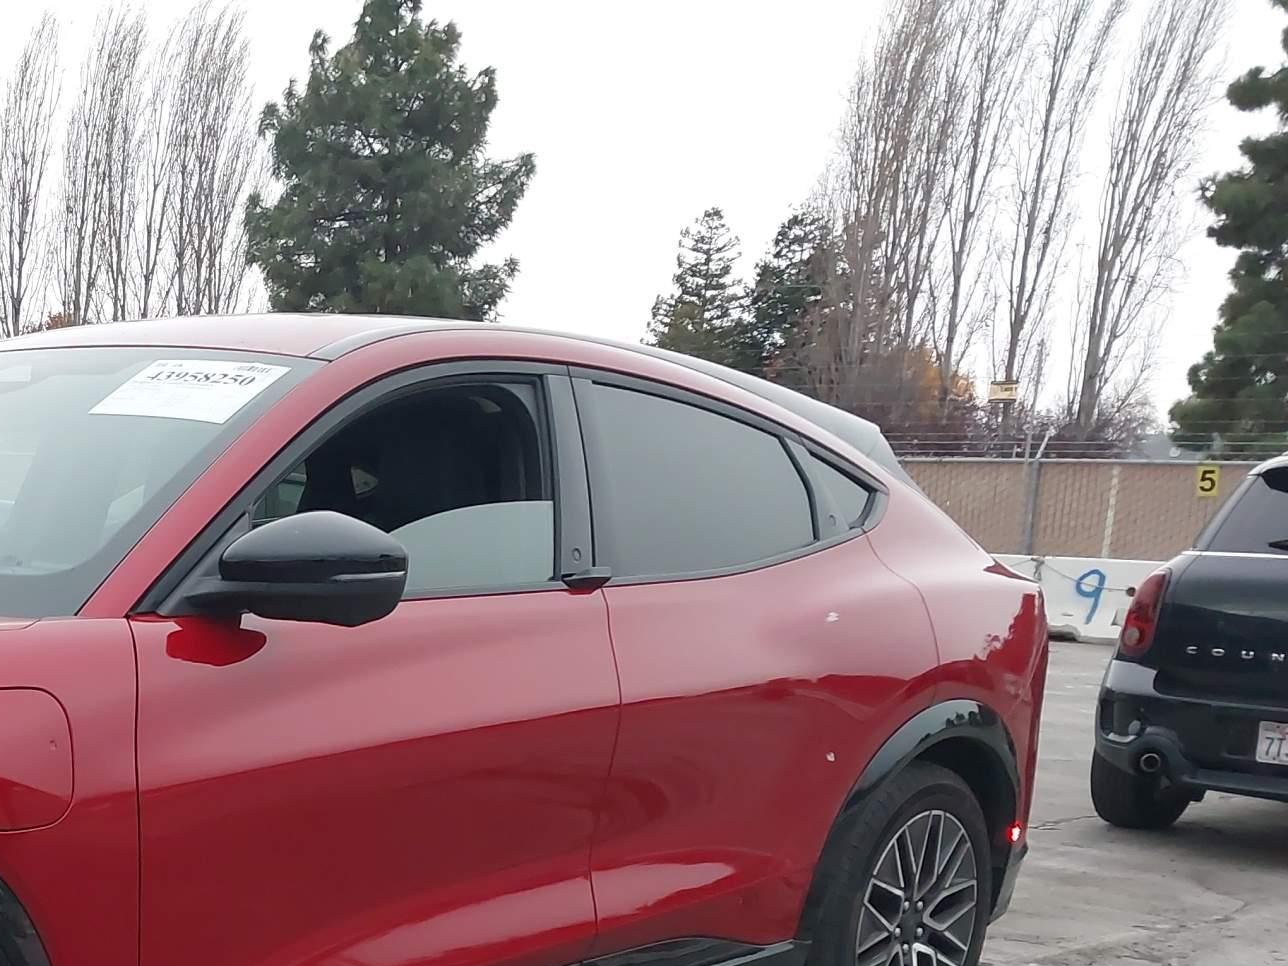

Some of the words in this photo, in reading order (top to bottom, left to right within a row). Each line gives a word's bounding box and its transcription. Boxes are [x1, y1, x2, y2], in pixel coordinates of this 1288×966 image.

[146, 370, 256, 386] 43958250
[1199, 469, 1216, 492] 5
[1075, 568, 1106, 625] 9
[1186, 645, 1286, 662] COUN
[1265, 736, 1288, 758] 7T
